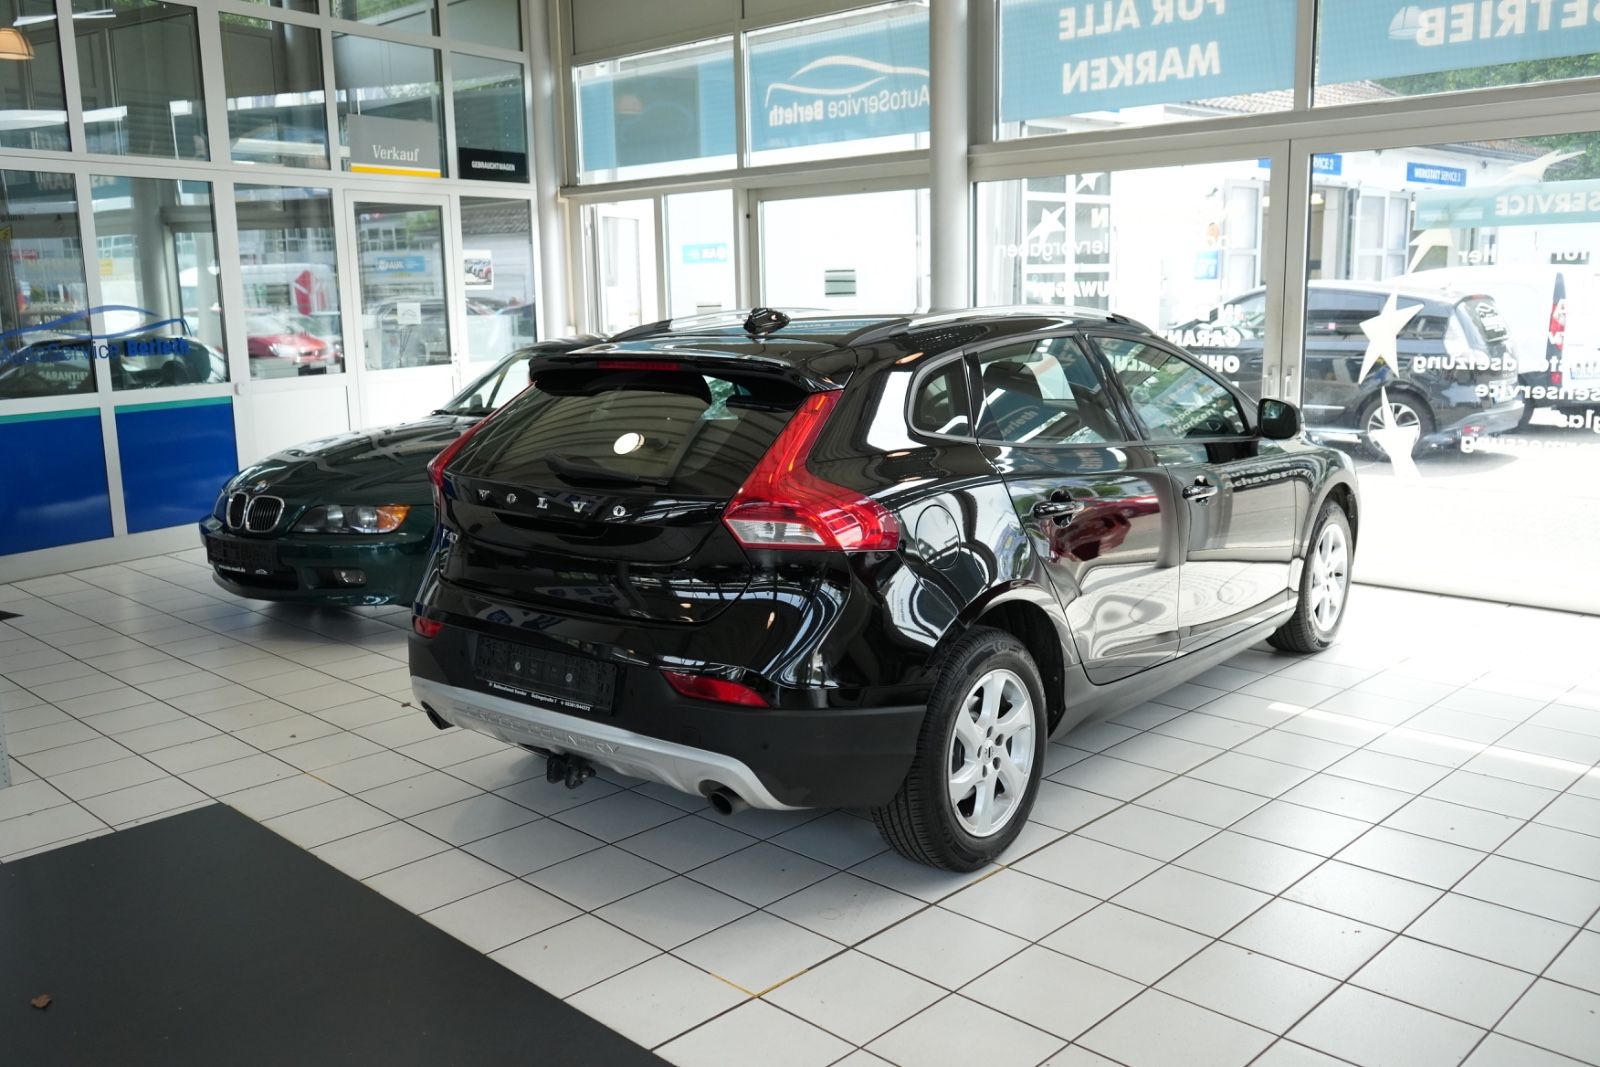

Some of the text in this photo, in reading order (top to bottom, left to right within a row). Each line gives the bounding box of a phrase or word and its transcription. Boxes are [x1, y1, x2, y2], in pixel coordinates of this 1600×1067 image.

[372, 144, 420, 162] Verkauf
[471, 160, 516, 172] GEBRAUCHTWAGEN
[125, 337, 191, 357] Berleth
[478, 489, 627, 517] VOLVO
